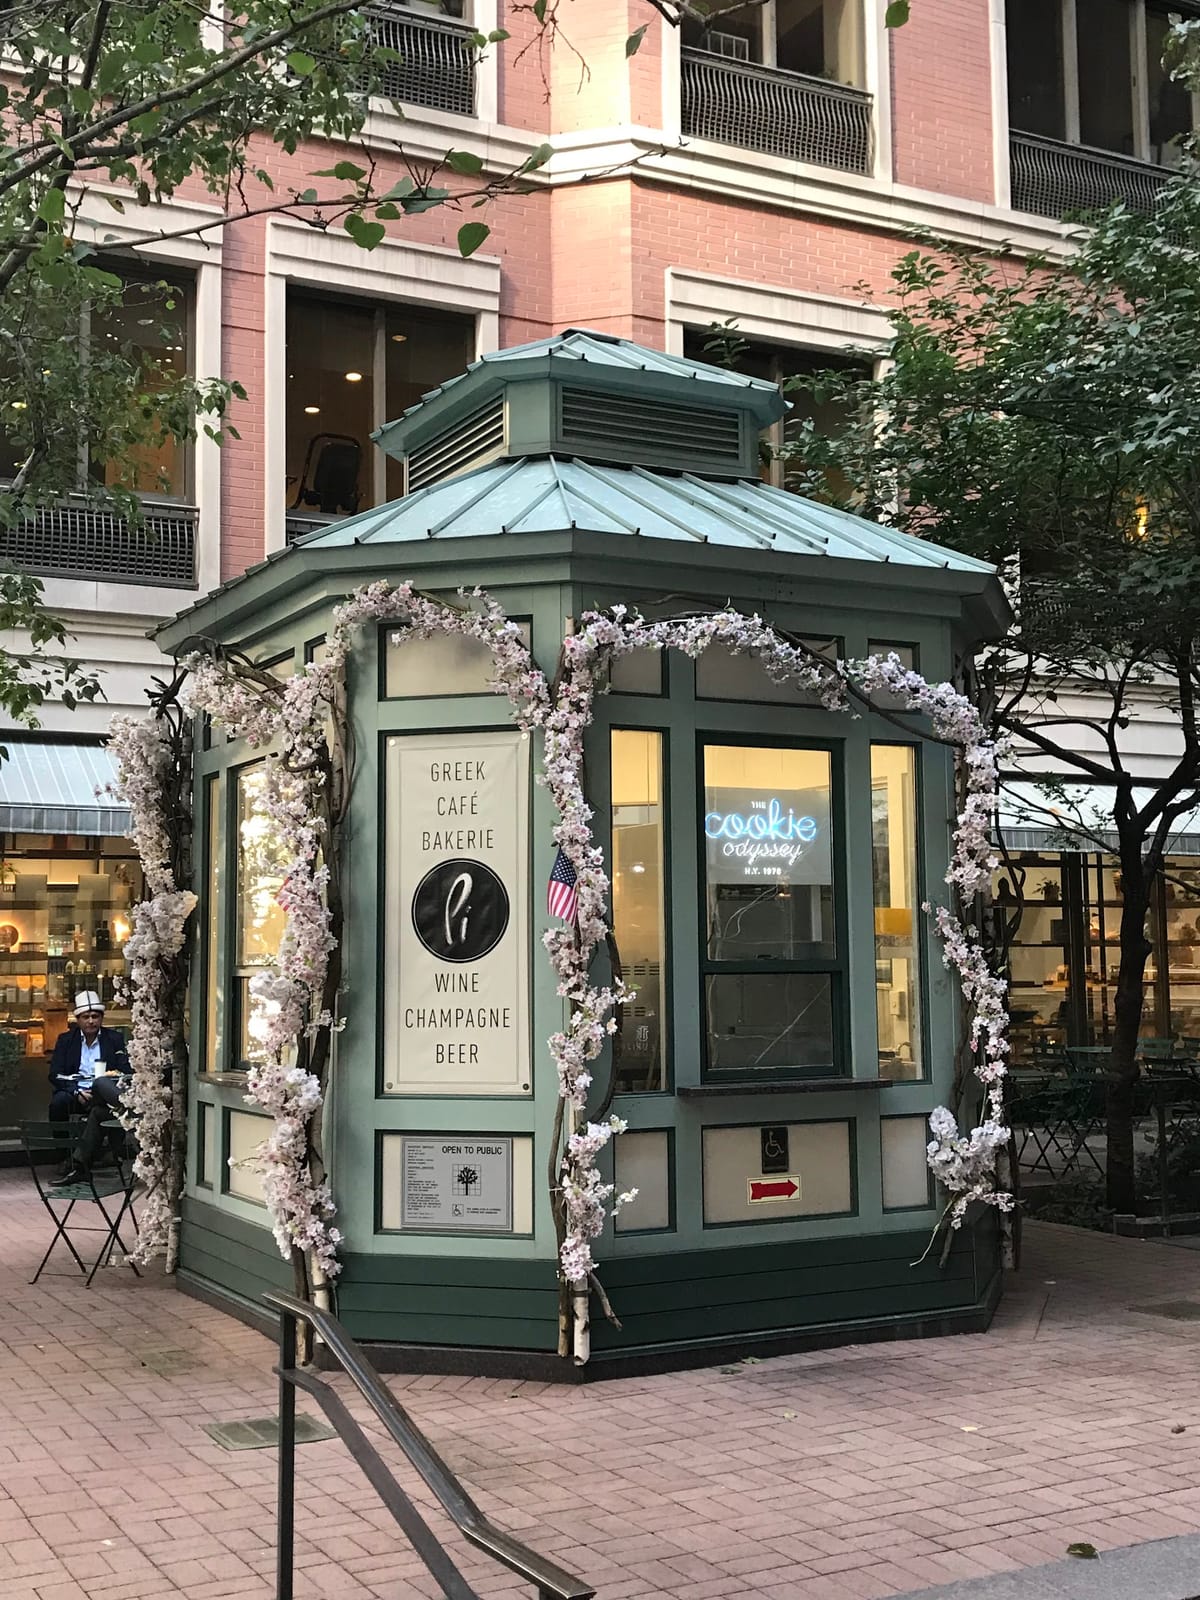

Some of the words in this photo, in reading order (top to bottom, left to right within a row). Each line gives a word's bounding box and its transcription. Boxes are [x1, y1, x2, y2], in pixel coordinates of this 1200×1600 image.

[430, 761, 486, 782] GREEK
[437, 791, 479, 816] CAFÉ
[751, 800, 767, 809] THE
[705, 798, 817, 841] cookie
[422, 829, 495, 851] BAKERIE
[723, 838, 803, 866] odyssey
[434, 972, 480, 993] WINE
[405, 1008, 511, 1029] CHAMPAGNE
[436, 1043, 479, 1064] BEER
[441, 1145, 462, 1154] OPEN
[464, 1146, 474, 1154] TO
[476, 1146, 503, 1155] PUBLIC
